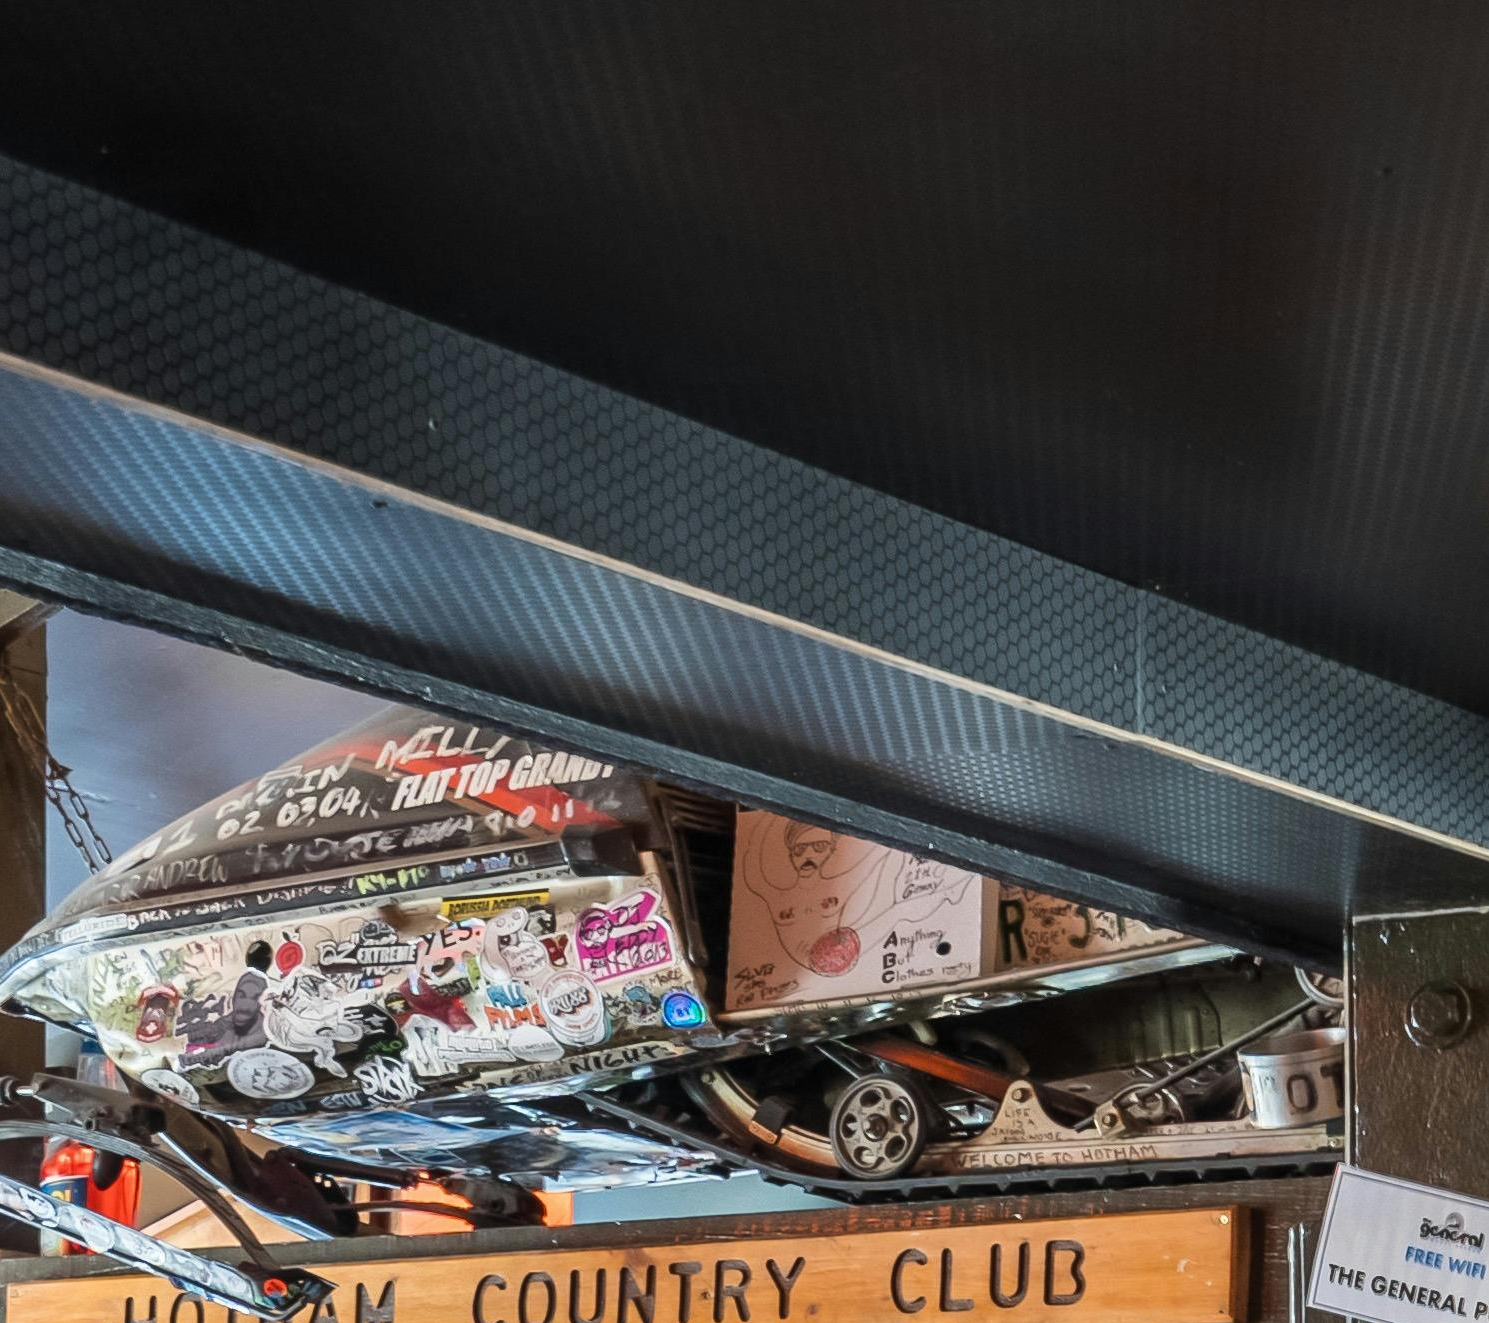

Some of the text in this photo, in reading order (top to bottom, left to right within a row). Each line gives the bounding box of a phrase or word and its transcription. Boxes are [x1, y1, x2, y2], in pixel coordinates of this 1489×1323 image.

[391, 768, 458, 812] FLAT
[454, 758, 511, 800] TOP
[356, 944, 418, 965] EXTREME
[882, 929, 945, 955] Anything
[882, 951, 911, 970] But
[881, 967, 934, 984] Clothes
[951, 1144, 1158, 1168] WELCOME TO HOTHAM
[1405, 1245, 1487, 1281] FREE WIFI
[889, 1239, 1088, 1314] CLUB
[1328, 1263, 1366, 1290] THE
[1370, 1275, 1467, 1317] GENERAL
